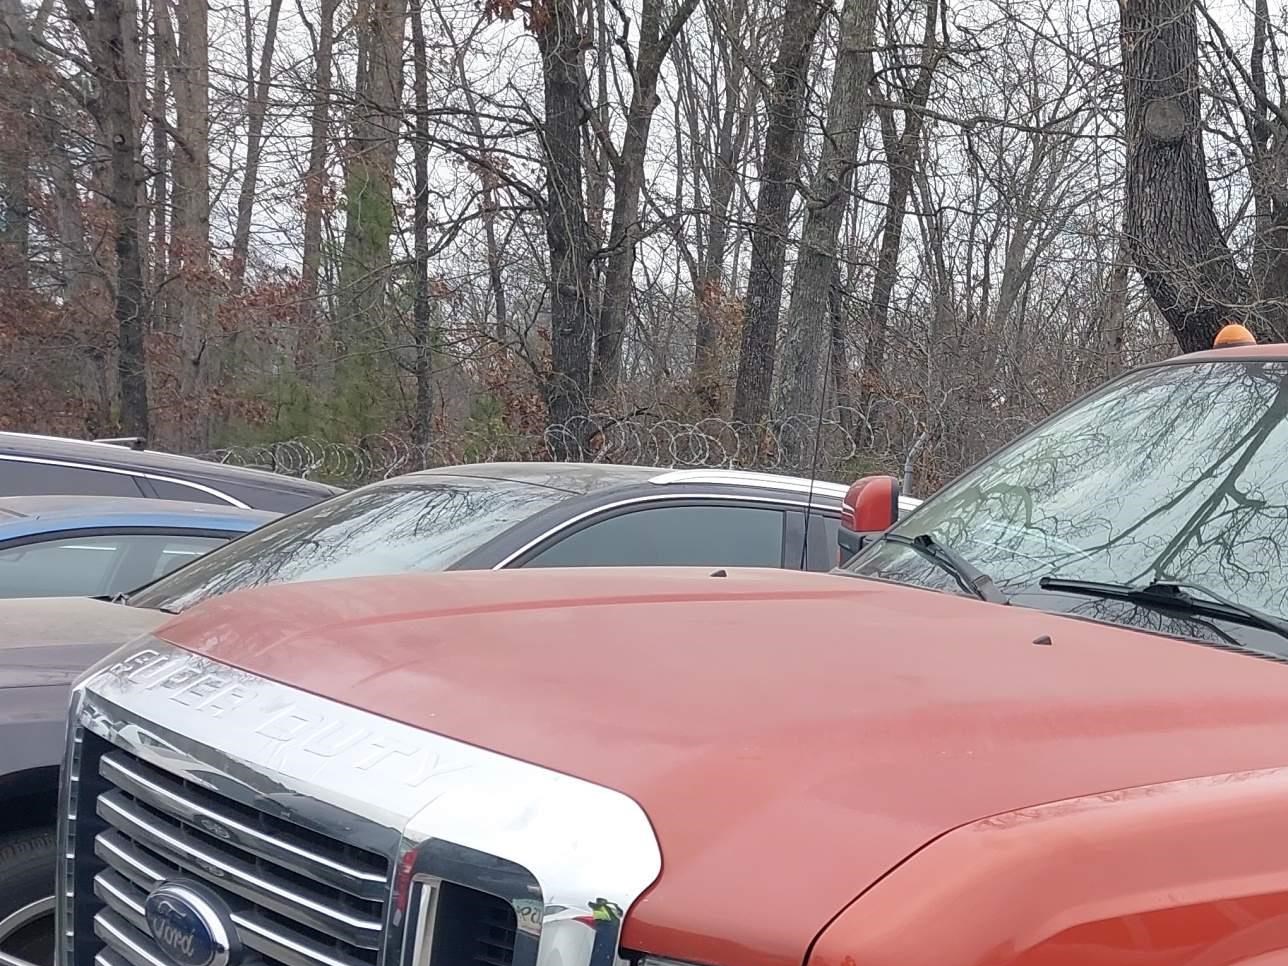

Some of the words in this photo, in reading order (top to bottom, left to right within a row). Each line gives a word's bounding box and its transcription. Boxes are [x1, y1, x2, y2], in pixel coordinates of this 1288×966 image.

[110, 648, 259, 719] SUPER
[255, 704, 473, 788] DUTY
[153, 900, 195, 957] Ford
